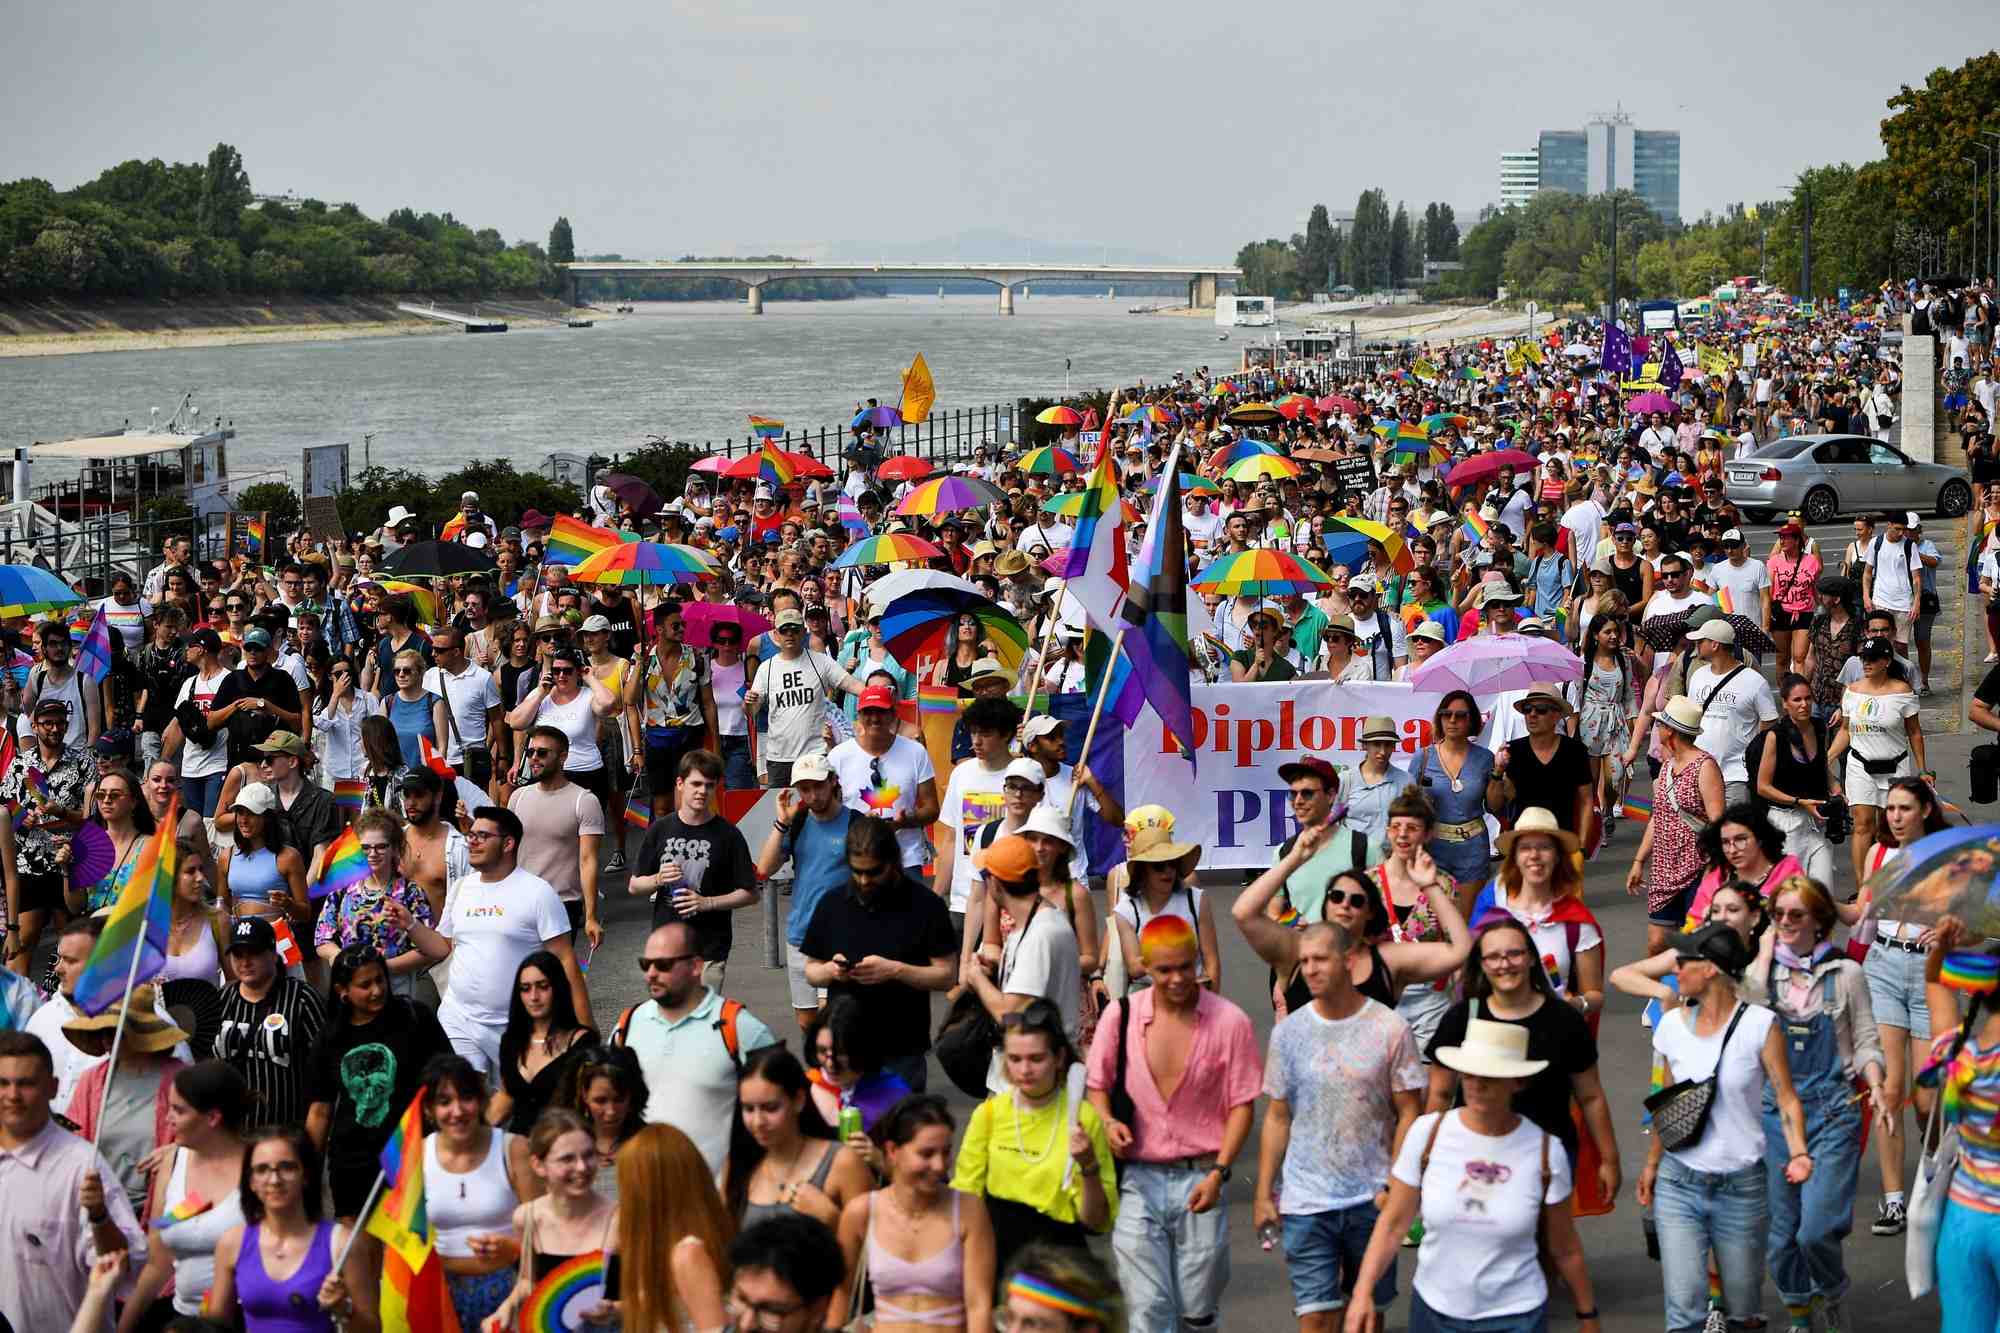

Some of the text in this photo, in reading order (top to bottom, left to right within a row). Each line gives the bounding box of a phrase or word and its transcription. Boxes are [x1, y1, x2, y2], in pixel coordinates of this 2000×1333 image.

[782, 671, 804, 689] BE
[776, 687, 814, 708] KIND
[236, 922, 252, 936] NY
